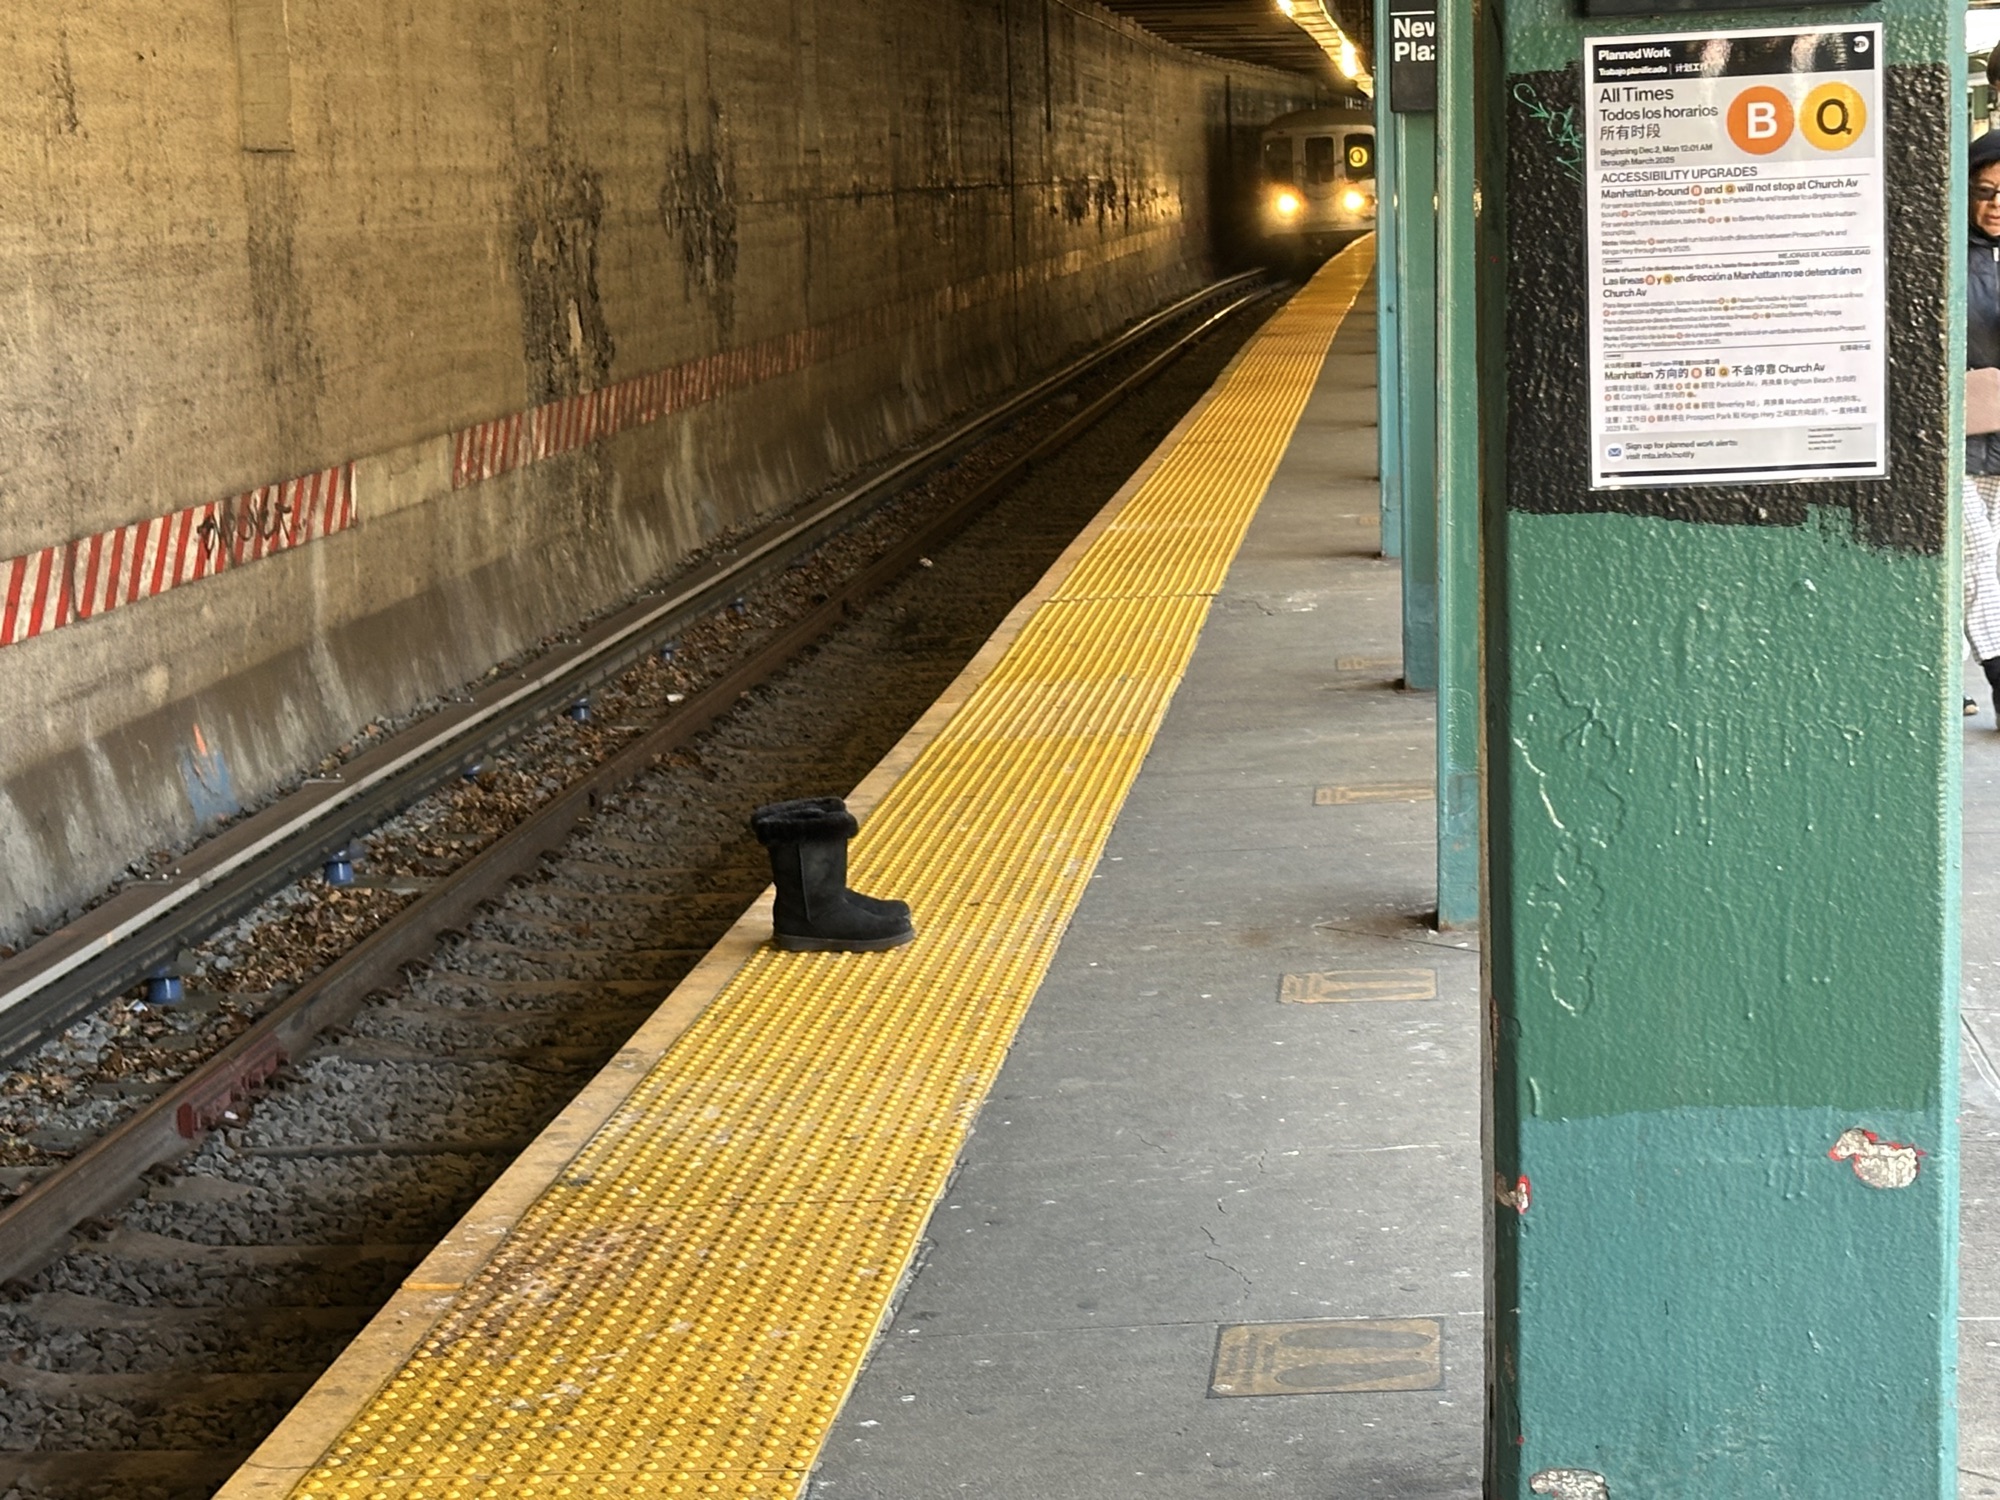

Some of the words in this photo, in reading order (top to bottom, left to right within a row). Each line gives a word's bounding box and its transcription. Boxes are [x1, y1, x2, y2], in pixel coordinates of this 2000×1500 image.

[1598, 48, 1642, 60] Planned
[1643, 47, 1671, 58] Work
[1600, 88, 1620, 103] All
[1623, 87, 1674, 101] Times
[1600, 109, 1640, 121] Todos
[1643, 107, 1661, 119] los
[1664, 105, 1718, 118] horarios
[1748, 102, 1778, 139] B
[1816, 99, 1852, 135] Q
[1600, 123, 1661, 140] 所有时段
[1600, 147, 1638, 156] Beginning
[1639, 146, 1654, 154] Dec
[1663, 145, 1679, 153] Mon
[1681, 144, 1699, 152] 12:01
[1700, 143, 1713, 151] AM
[1656, 156, 1675, 164] 2025
[1601, 170, 1690, 183] ACCESSIBILITY
[1692, 167, 1757, 179] UPGRADES
[1601, 186, 1689, 199] Manhattan-bound
[1704, 185, 1723, 194] and
[1737, 183, 1754, 192] will
[1755, 183, 1771, 191] not
[1773, 182, 1795, 192] stop
[1797, 181, 1806, 189] at
[1807, 179, 1843, 189] Church
[1845, 178, 1858, 187] Av
[1603, 276, 1618, 286] Las
[1620, 276, 1644, 285] líneas
[1686, 272, 1726, 282] dirección
[1734, 270, 1780, 280] Manhattan
[1781, 270, 1792, 278] no
[1805, 266, 1850, 277] detendrán
[1850, 267, 1862, 275] en
[1603, 289, 1635, 298] Church
[1635, 288, 1647, 297] Av
[1604, 371, 1653, 380] Manhattan
[1655, 368, 1689, 379] 方向的
[1705, 367, 1716, 377] 和
[1731, 363, 1776, 376] 不会停靠
[1778, 363, 1812, 373] Church
[1813, 363, 1825, 371] Av
[1625, 442, 1642, 450] Sign
[1665, 440, 1695, 450] planned
[1696, 439, 1714, 447] work
[1626, 452, 1640, 460] visit
